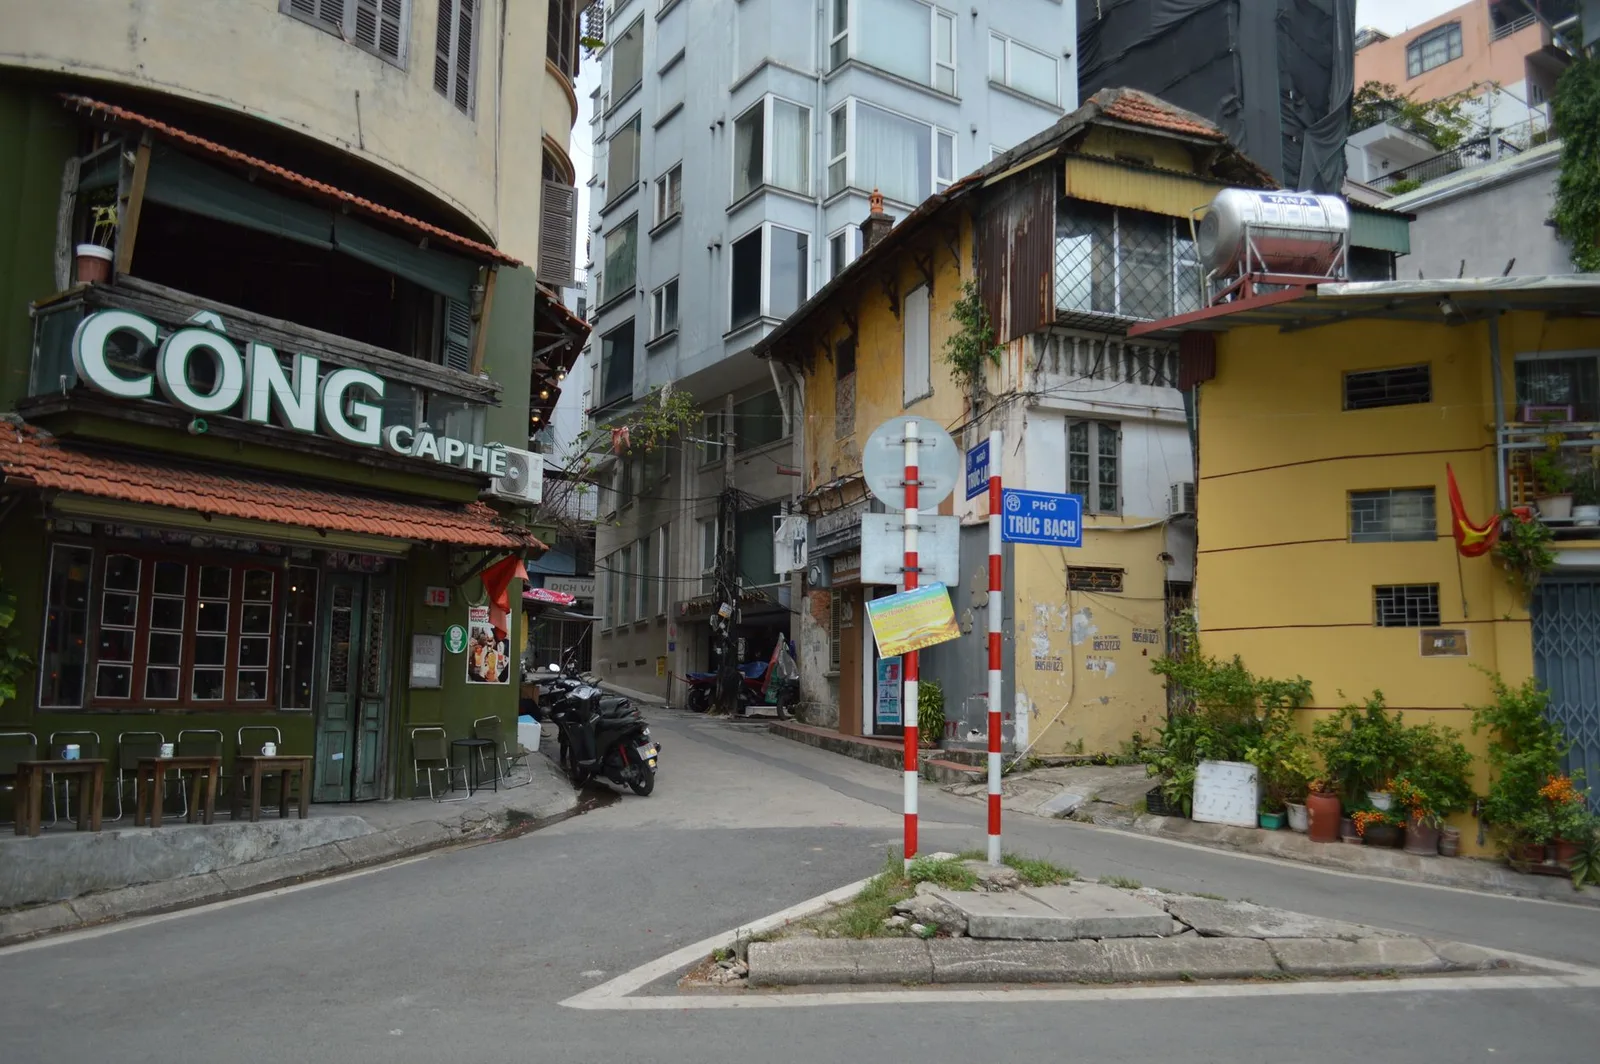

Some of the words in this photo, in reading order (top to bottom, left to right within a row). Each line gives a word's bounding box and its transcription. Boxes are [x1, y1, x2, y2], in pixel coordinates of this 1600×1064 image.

[73, 308, 386, 447] CỘNG
[1032, 497, 1057, 511] PHỐ
[1008, 512, 1040, 535] TRÚC
[1043, 517, 1076, 540] BẠCH
